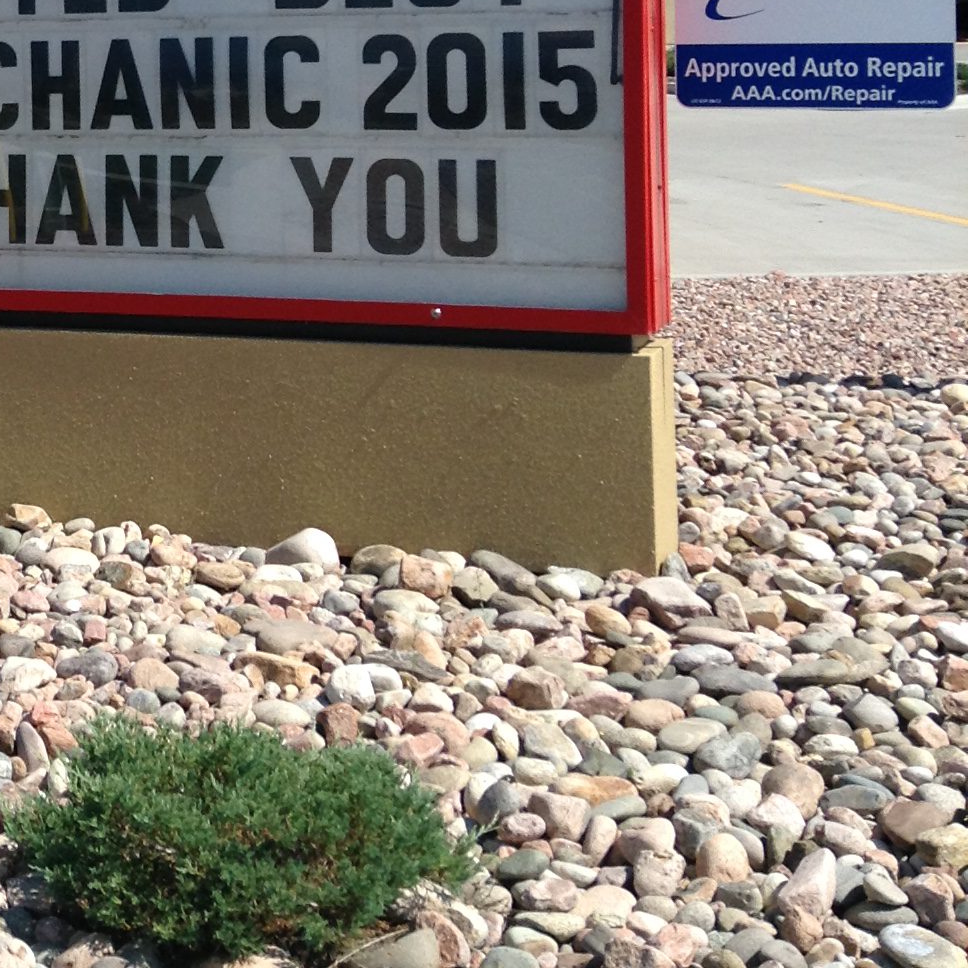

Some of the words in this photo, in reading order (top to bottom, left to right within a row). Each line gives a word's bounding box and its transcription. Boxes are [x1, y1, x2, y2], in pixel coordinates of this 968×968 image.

[362, 29, 599, 132] 2015
[684, 57, 796, 83] Approved
[801, 57, 859, 78] Auto
[867, 56, 945, 83] Repair
[731, 84, 896, 105] AAA.com/Repair
[288, 156, 499, 258] YOU
